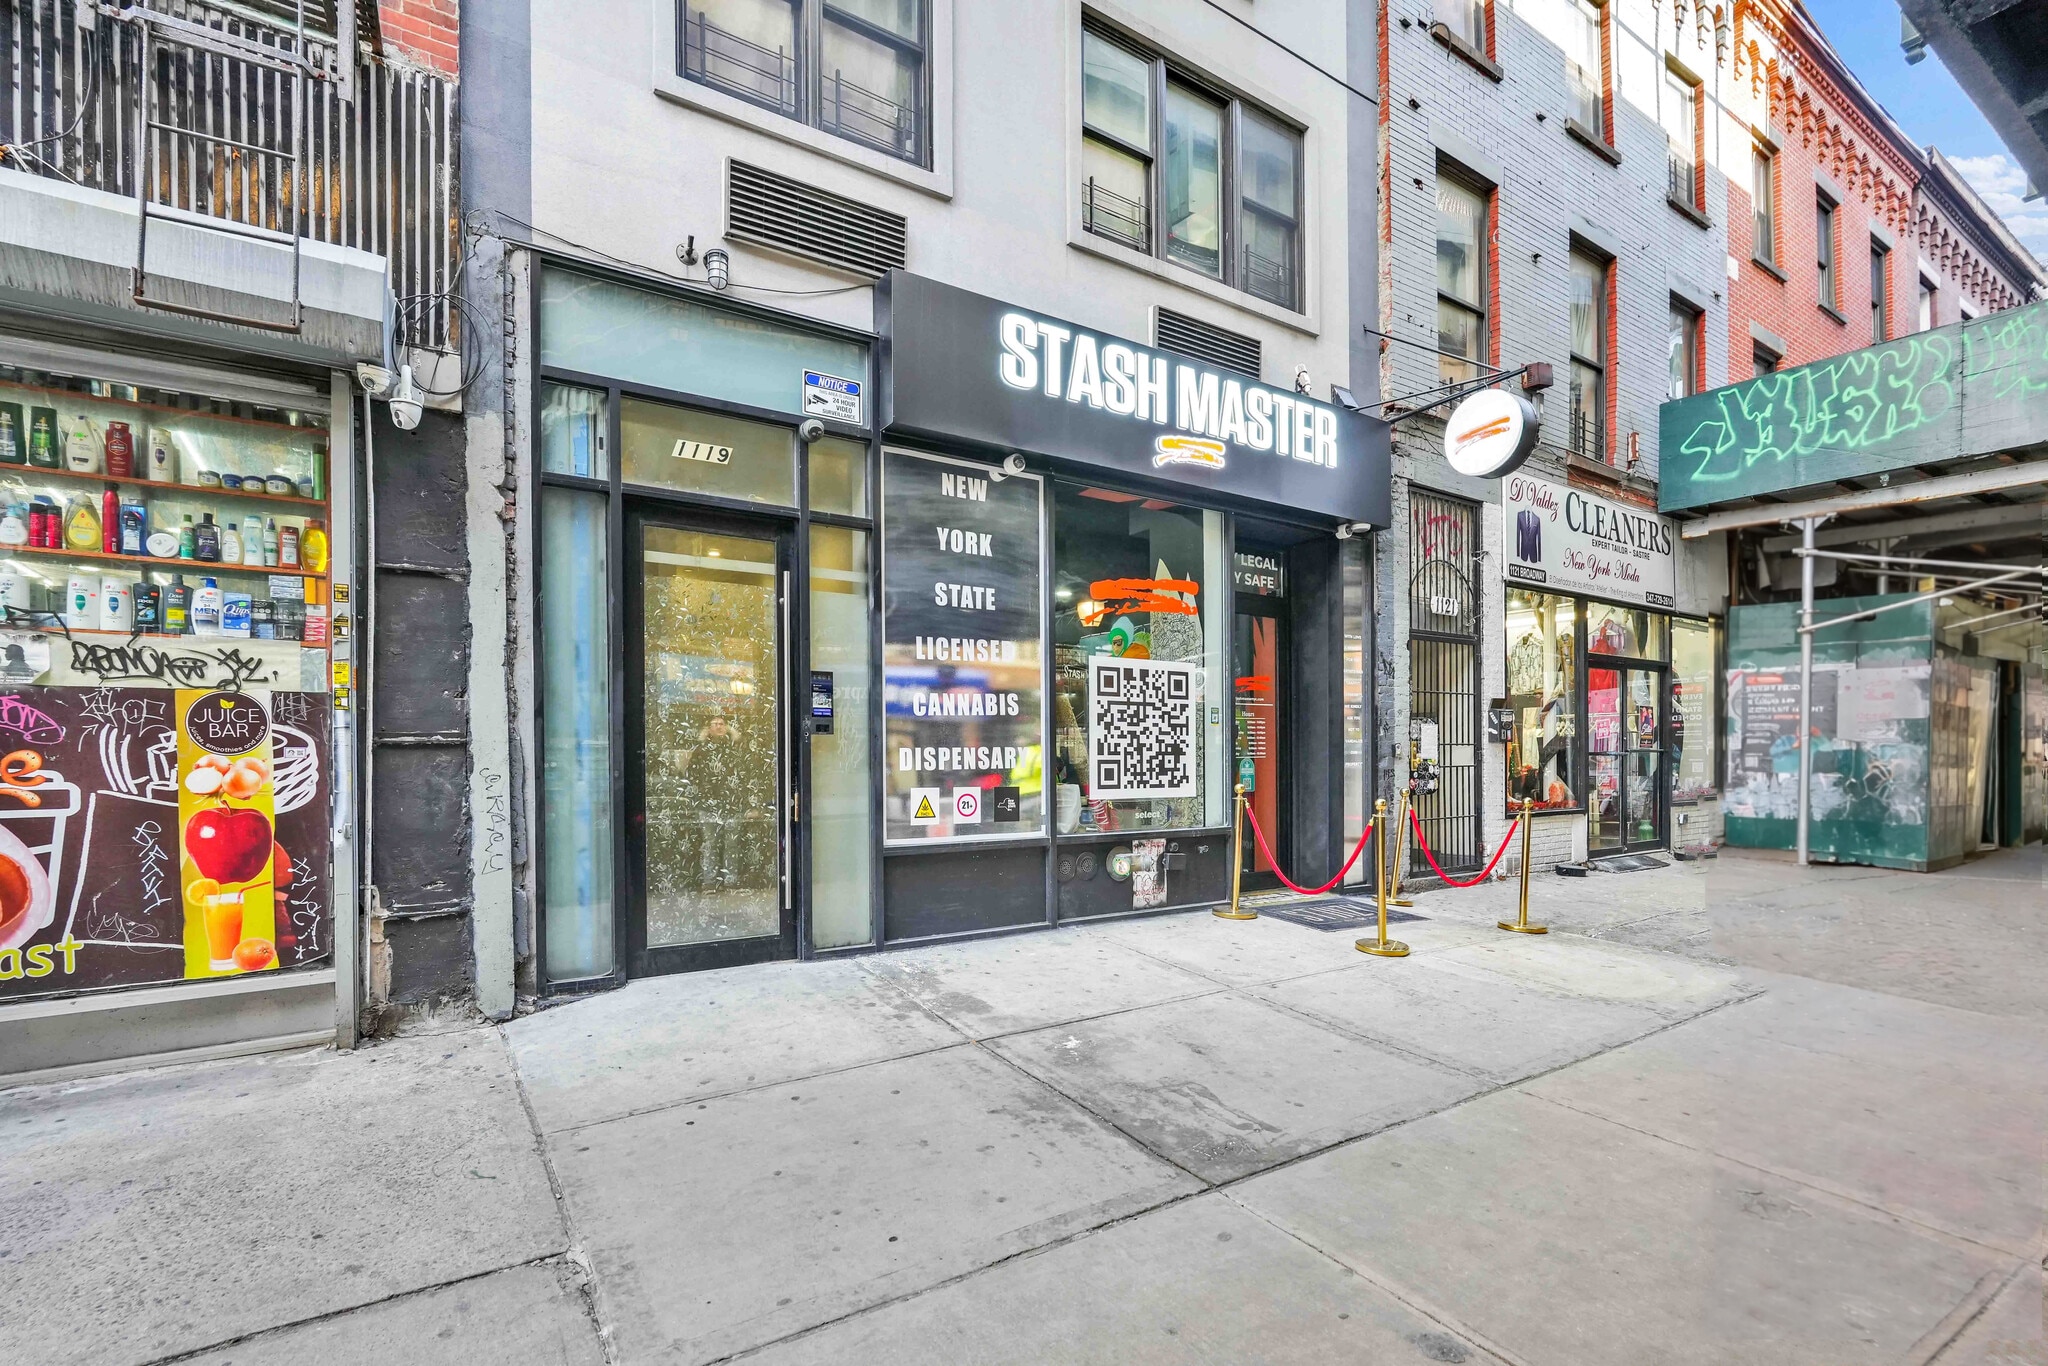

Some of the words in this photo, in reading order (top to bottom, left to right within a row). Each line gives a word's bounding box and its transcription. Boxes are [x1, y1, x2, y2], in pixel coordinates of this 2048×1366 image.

[818, 377, 848, 392] NOTICE
[999, 313, 1168, 424] STASH
[1176, 365, 1338, 468] MASTER
[835, 405, 853, 414] VIDEO
[840, 399, 856, 408] HOUR
[822, 409, 856, 419] SURVEILLANCE
[677, 441, 730, 463] 1119
[941, 472, 988, 502] NEW
[1527, 482, 1559, 522] Valdez
[1566, 491, 1671, 556] CLEANERS
[936, 526, 993, 557] YORK
[1591, 538, 1611, 551] EXPERT
[1611, 543, 1628, 555] TAILOR
[1632, 549, 1650, 561] SASTRE
[1240, 553, 1278, 571] LEGAL
[1563, 547, 1586, 569] New
[1587, 554, 1612, 580] York
[1614, 559, 1641, 583] Moda
[1244, 573, 1275, 588] SAFE
[1509, 564, 1521, 576] 1121
[1520, 567, 1547, 582] BROADWAY
[934, 582, 996, 611] STATE
[1436, 597, 1455, 615] 1121
[194, 607, 220, 615] MEN
[915, 636, 1016, 663] LICENSED
[912, 692, 1020, 716] CANNABIS
[194, 708, 260, 723] JUICE
[205, 742, 243, 753] smoothies
[243, 738, 257, 749] and
[255, 725, 266, 741] more
[209, 723, 249, 738] BAR
[899, 747, 1029, 771] DISPENSARY
[961, 801, 973, 810] 21+
[1134, 811, 1161, 819] select
